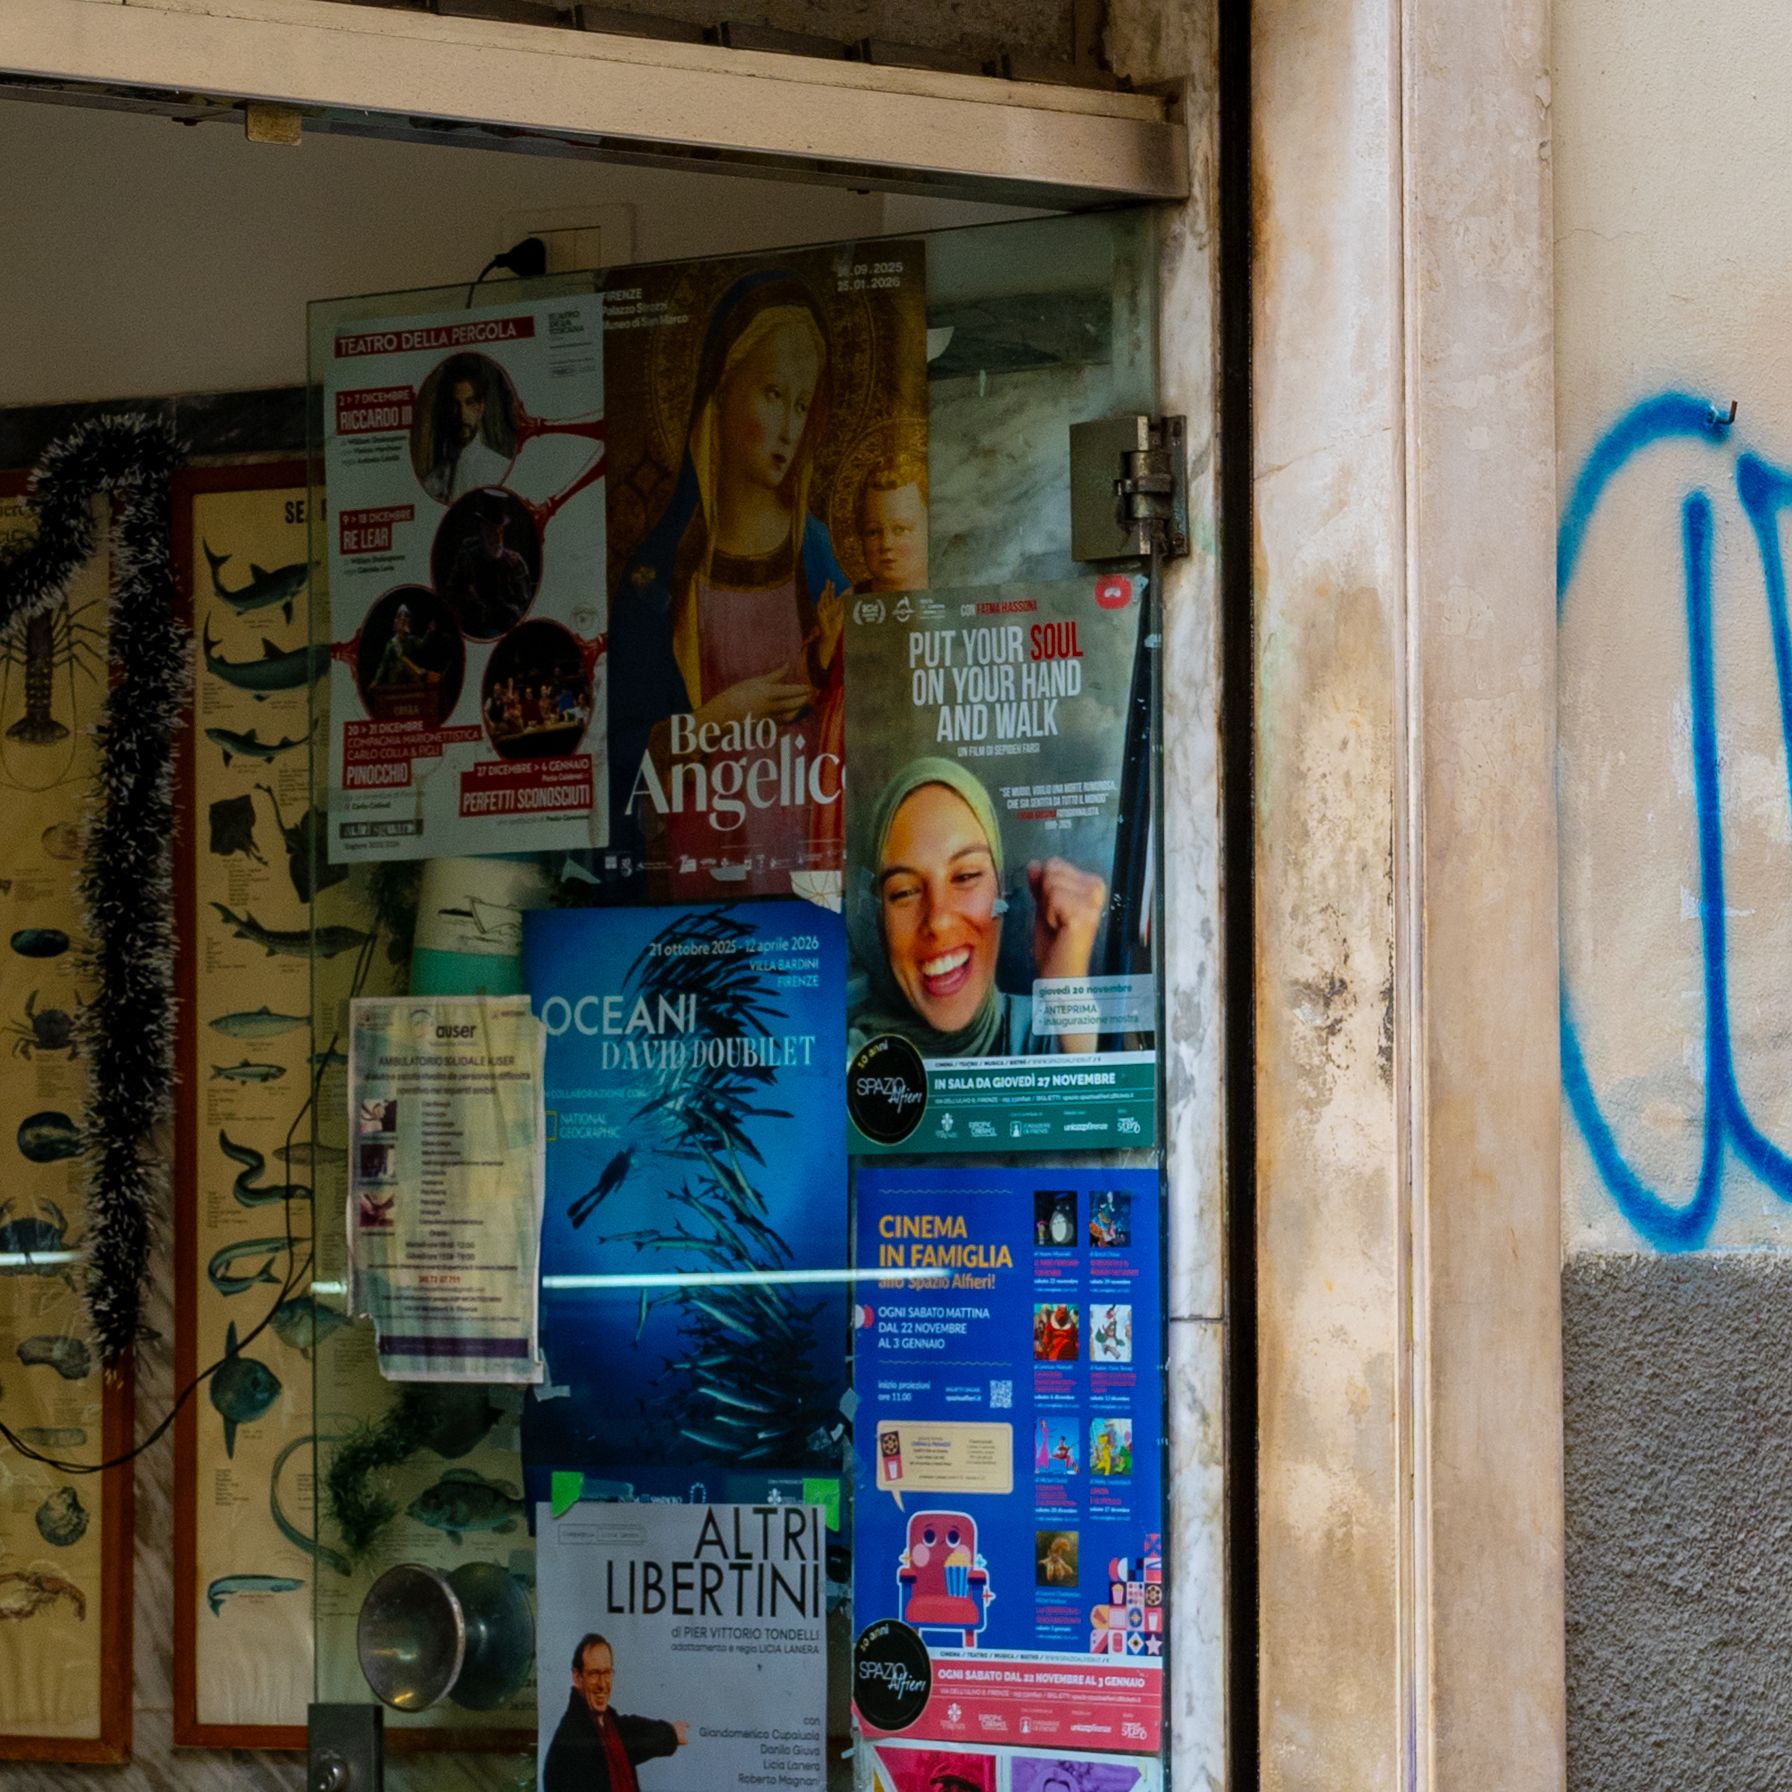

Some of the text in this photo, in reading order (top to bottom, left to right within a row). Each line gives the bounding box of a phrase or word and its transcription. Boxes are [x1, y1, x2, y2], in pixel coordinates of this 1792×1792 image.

[340, 321, 517, 355] TEATRO DELLA PERGOLA
[343, 528, 388, 550] RE LEAR
[909, 620, 1084, 669] PUT YOUR SOUL
[912, 659, 1082, 707] ON YOUR HAND
[670, 711, 777, 755] Beato
[937, 699, 1058, 742] AND WALK
[346, 763, 408, 785] PINOCCHIO
[624, 733, 846, 832] Angelic
[463, 785, 590, 813] PERFETTI SCONOSCIUTI
[777, 976, 819, 988] FIRENZE
[541, 993, 696, 1036] OCEANI
[1044, 1005, 1097, 1016] ANTEPRIMA
[436, 1024, 477, 1039] auser
[601, 1036, 816, 1070] DAVID DOUBILET
[934, 1073, 1116, 1090] IN SALA DA GIOVEDÌ 27 NOVEMBRE
[879, 1215, 967, 1239] CINEMA
[879, 1244, 1013, 1269] IN FAMIGLIA
[878, 1306, 990, 1319] OGNI SABATO MATTINA
[878, 1322, 967, 1335] DAL 22 NOVEMBRE
[692, 1506, 817, 1561] ALTRI
[606, 1559, 820, 1619] LIBERTINI
[671, 1627, 819, 1641] di PIER VITTORIO TONDELLI
